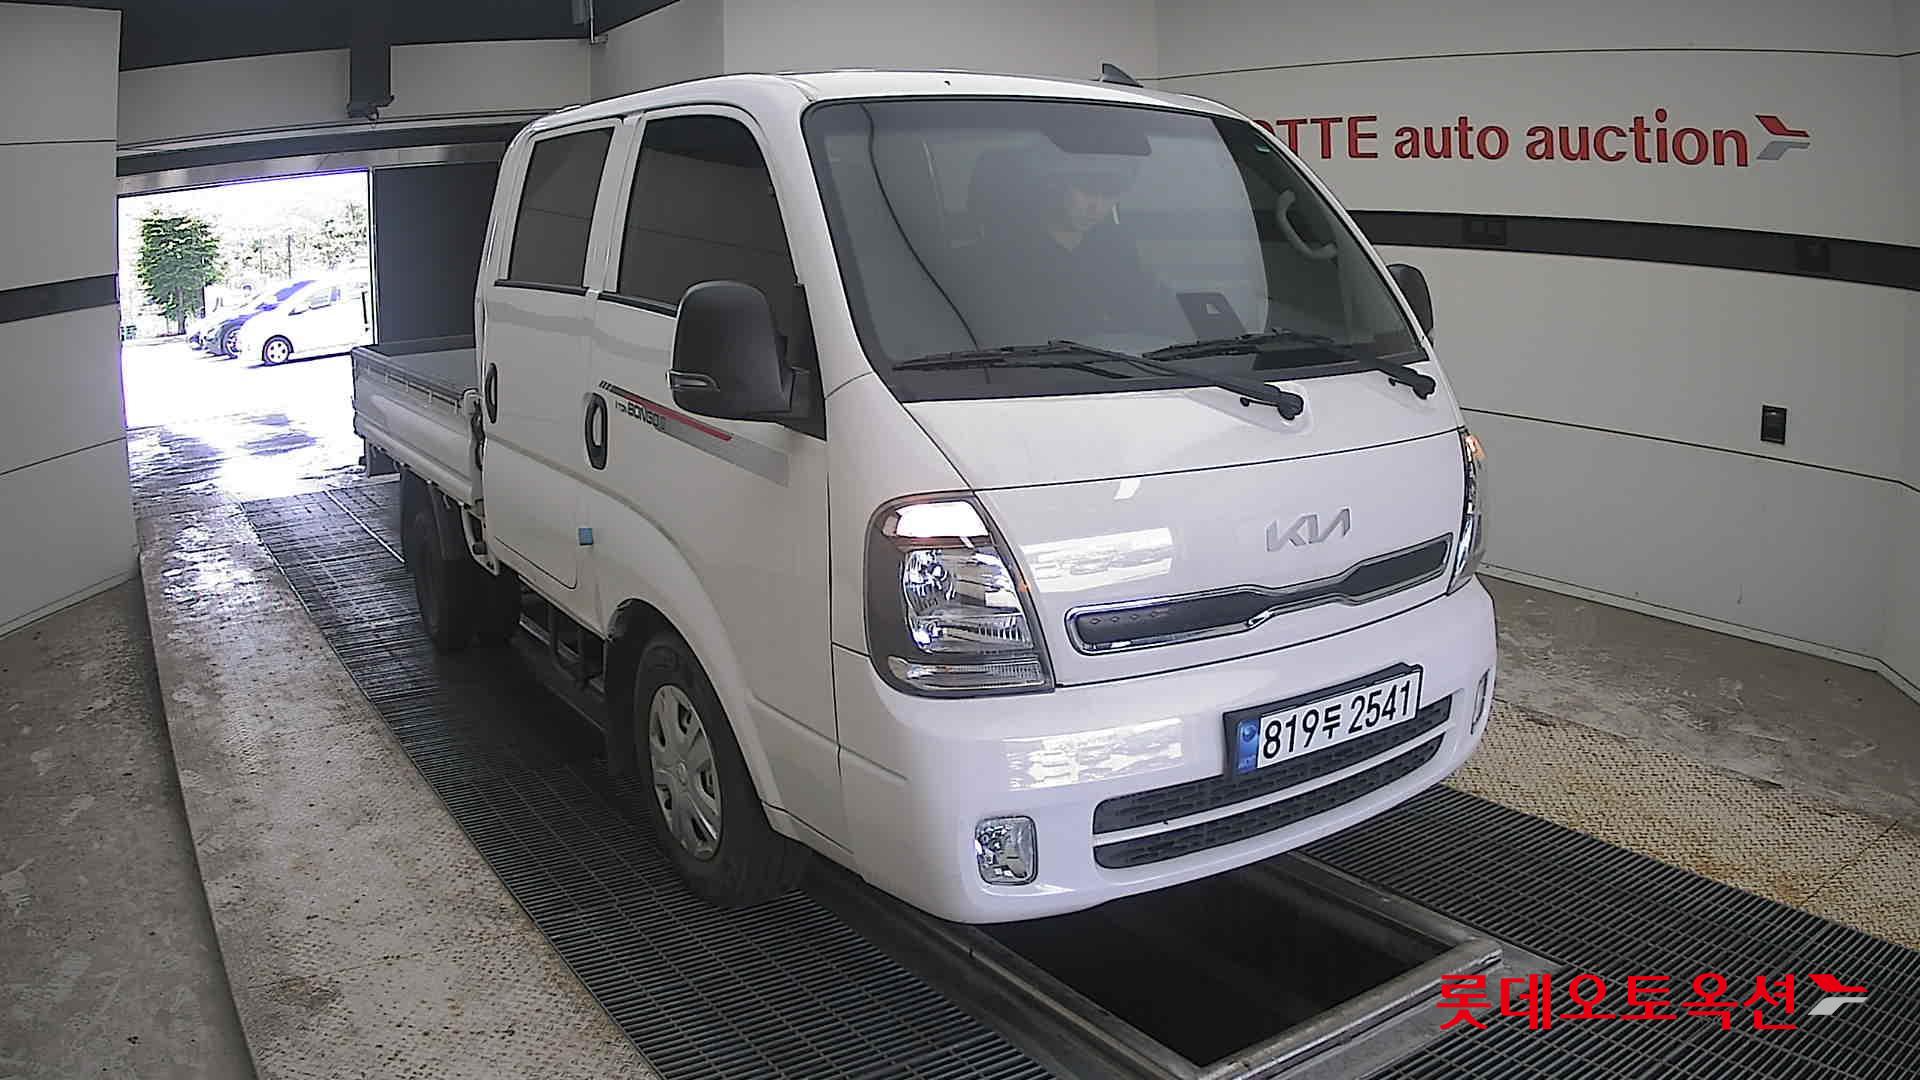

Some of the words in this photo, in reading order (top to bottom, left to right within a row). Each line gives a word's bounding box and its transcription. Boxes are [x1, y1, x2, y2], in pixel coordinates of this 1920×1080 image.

[1393, 115, 1510, 160] auto
[1525, 108, 1749, 167] auction
[1265, 507, 1351, 552] KIA
[1262, 703, 1342, 760] 819두
[1348, 679, 1411, 735] 2541
